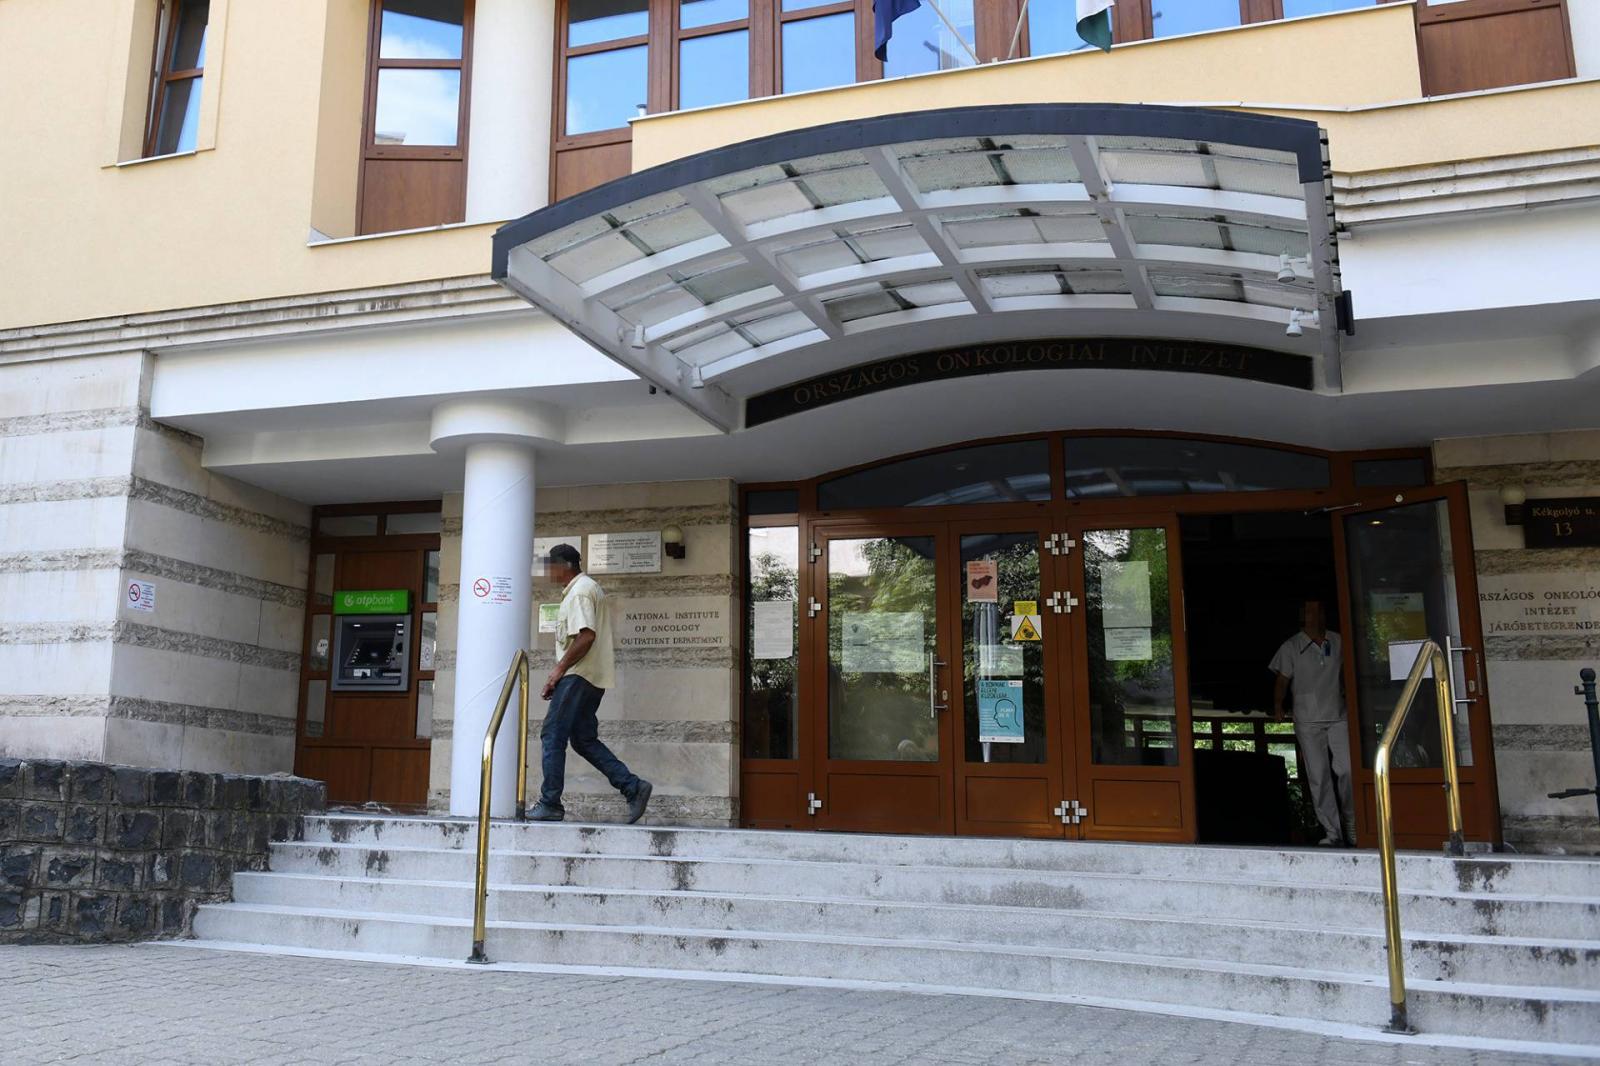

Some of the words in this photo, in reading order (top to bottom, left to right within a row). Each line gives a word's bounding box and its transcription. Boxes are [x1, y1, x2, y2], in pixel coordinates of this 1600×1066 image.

[1555, 522, 1573, 537] 13
[1479, 588, 1535, 601] RSZÁGOS
[625, 612, 670, 621] NATIONAL
[675, 611, 720, 620] INSTITUTE
[651, 624, 701, 632] ONCOLOGY
[621, 637, 670, 645] OUTPATIENT
[673, 636, 724, 645] DEPARTMENT
